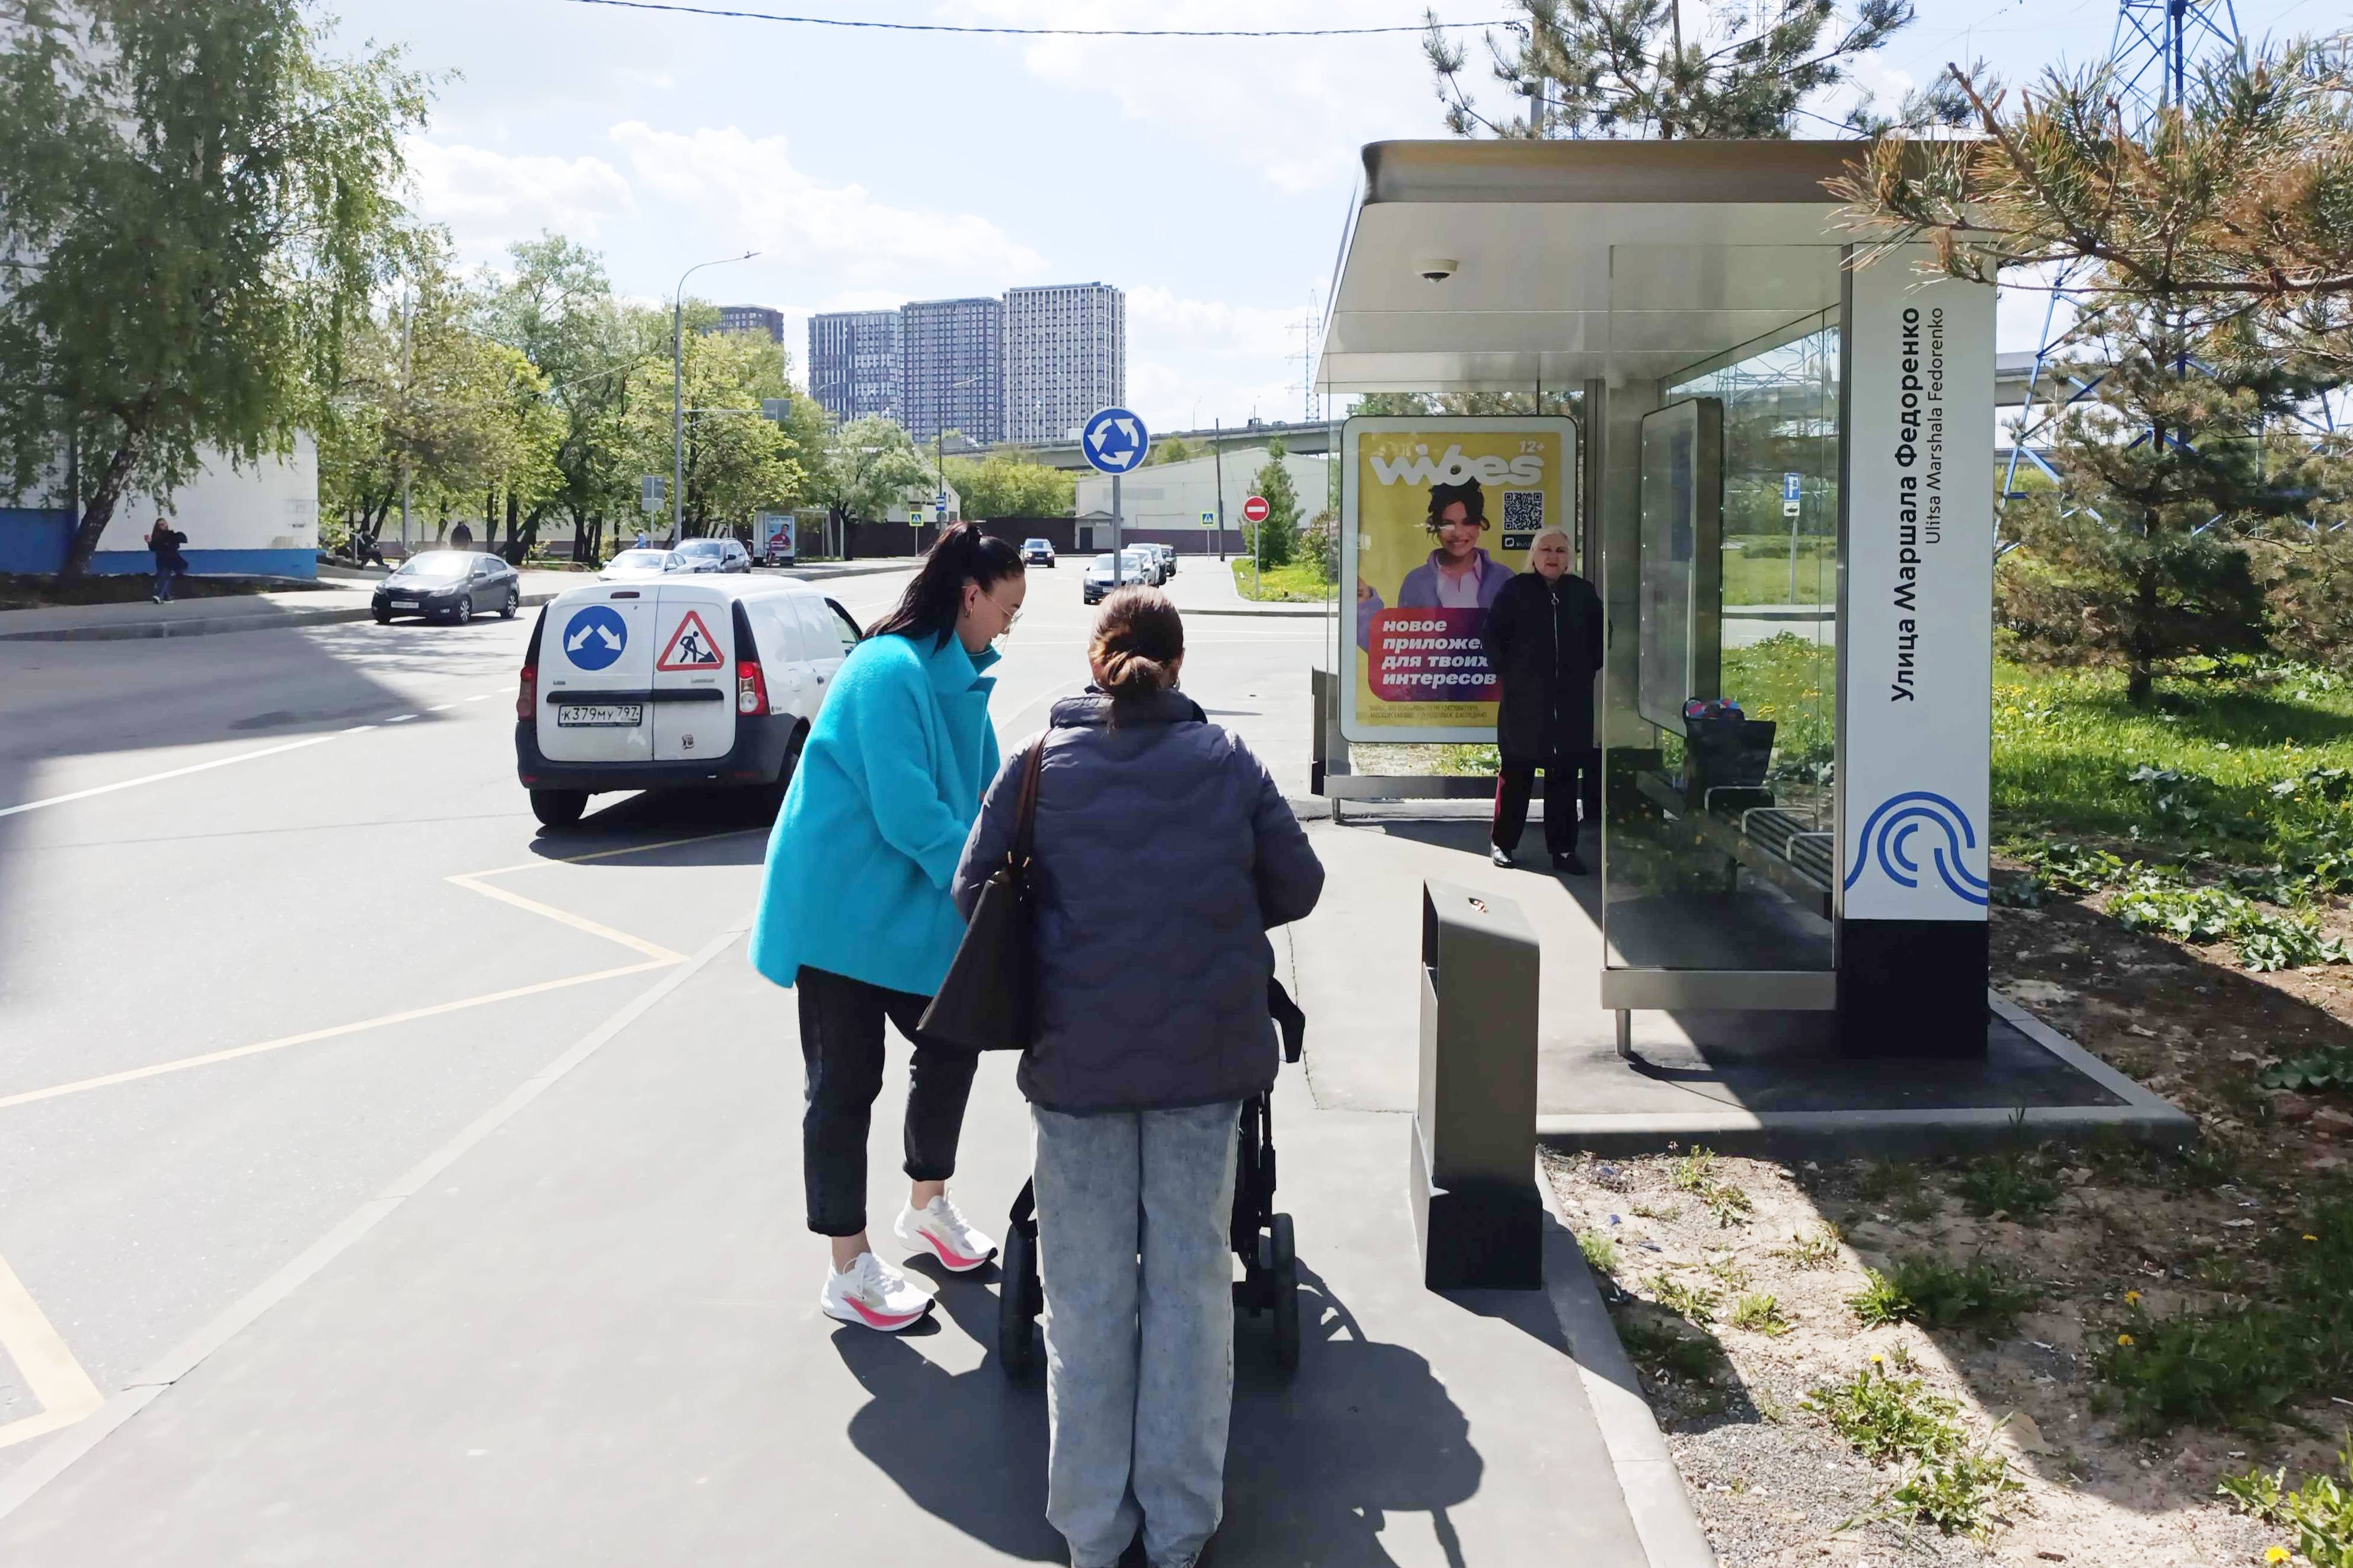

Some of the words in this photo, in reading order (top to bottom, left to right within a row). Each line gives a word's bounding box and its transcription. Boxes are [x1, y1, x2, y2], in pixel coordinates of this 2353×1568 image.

[1927, 308, 1943, 401] Fedorenko
[1894, 308, 1923, 467] Федоренко
[1519, 440, 1545, 453] 12+
[1926, 407, 1943, 490] Marshala
[1893, 476, 1921, 612] Маршала
[1925, 496, 1940, 544] Ulitsa
[1382, 620, 1447, 632] новое
[1382, 638, 1482, 654] приложе
[1381, 656, 1422, 670] для
[1427, 656, 1489, 668] твоих
[1382, 673, 1497, 689] интересов
[1891, 619, 1919, 702] Улица
